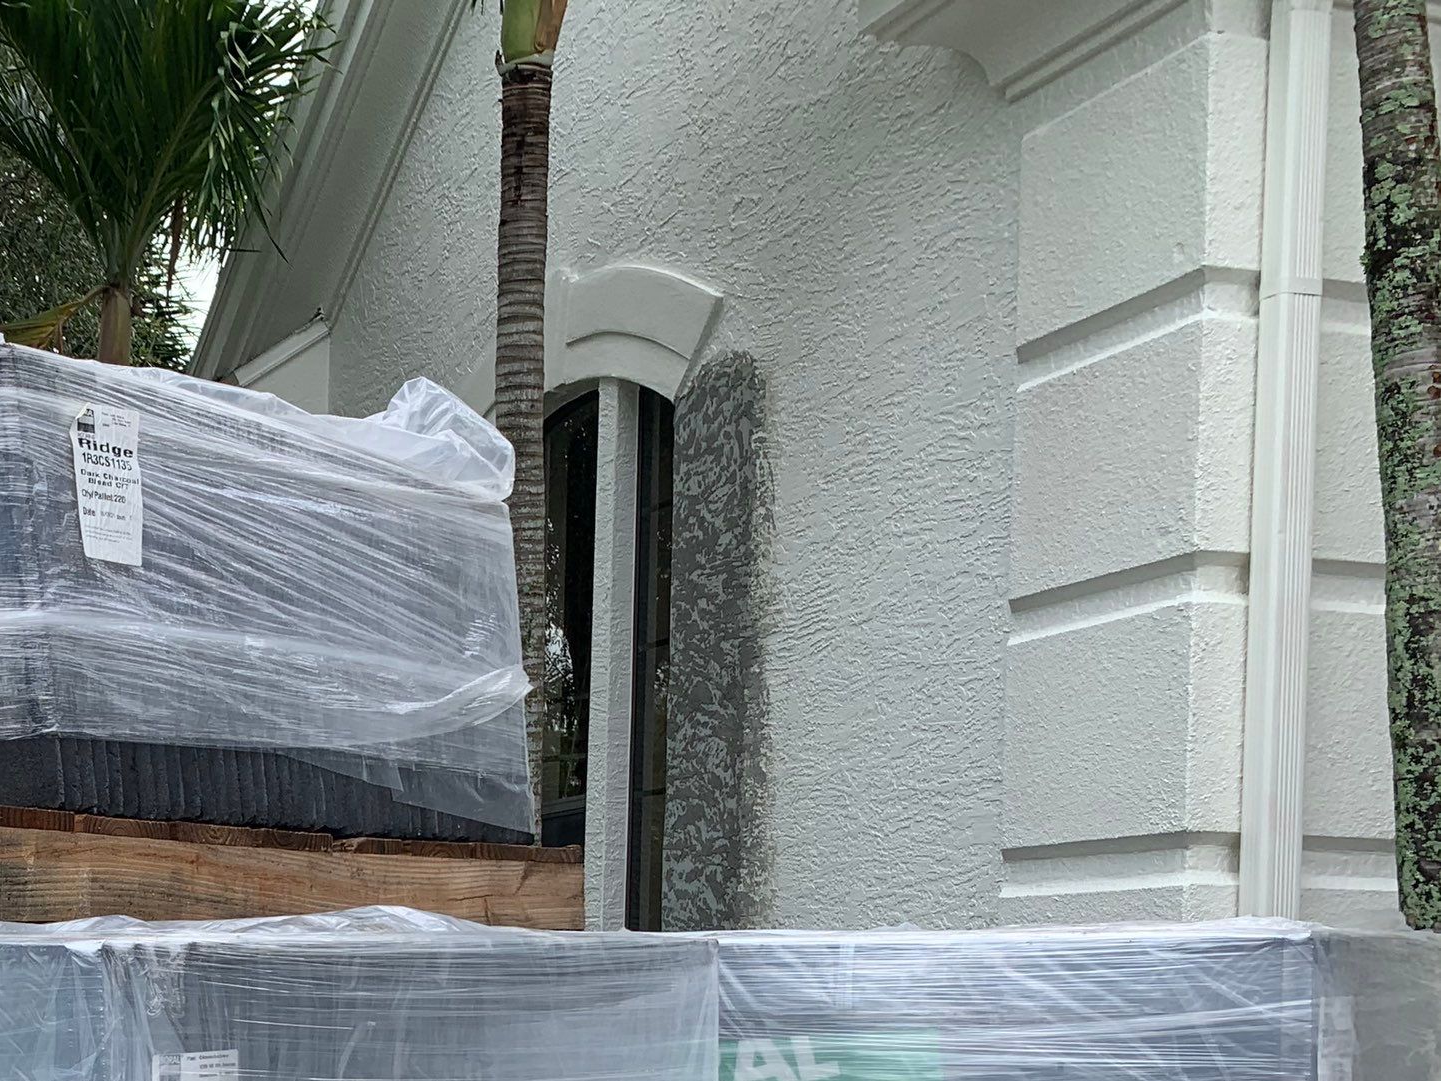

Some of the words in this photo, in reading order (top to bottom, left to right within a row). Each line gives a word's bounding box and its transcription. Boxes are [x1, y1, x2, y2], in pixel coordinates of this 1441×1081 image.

[78, 437, 134, 458] Ridge
[82, 452, 133, 471] 1R3CS1135
[80, 468, 100, 479] Dark
[103, 472, 140, 485] Charcoal
[88, 477, 113, 488] Blend
